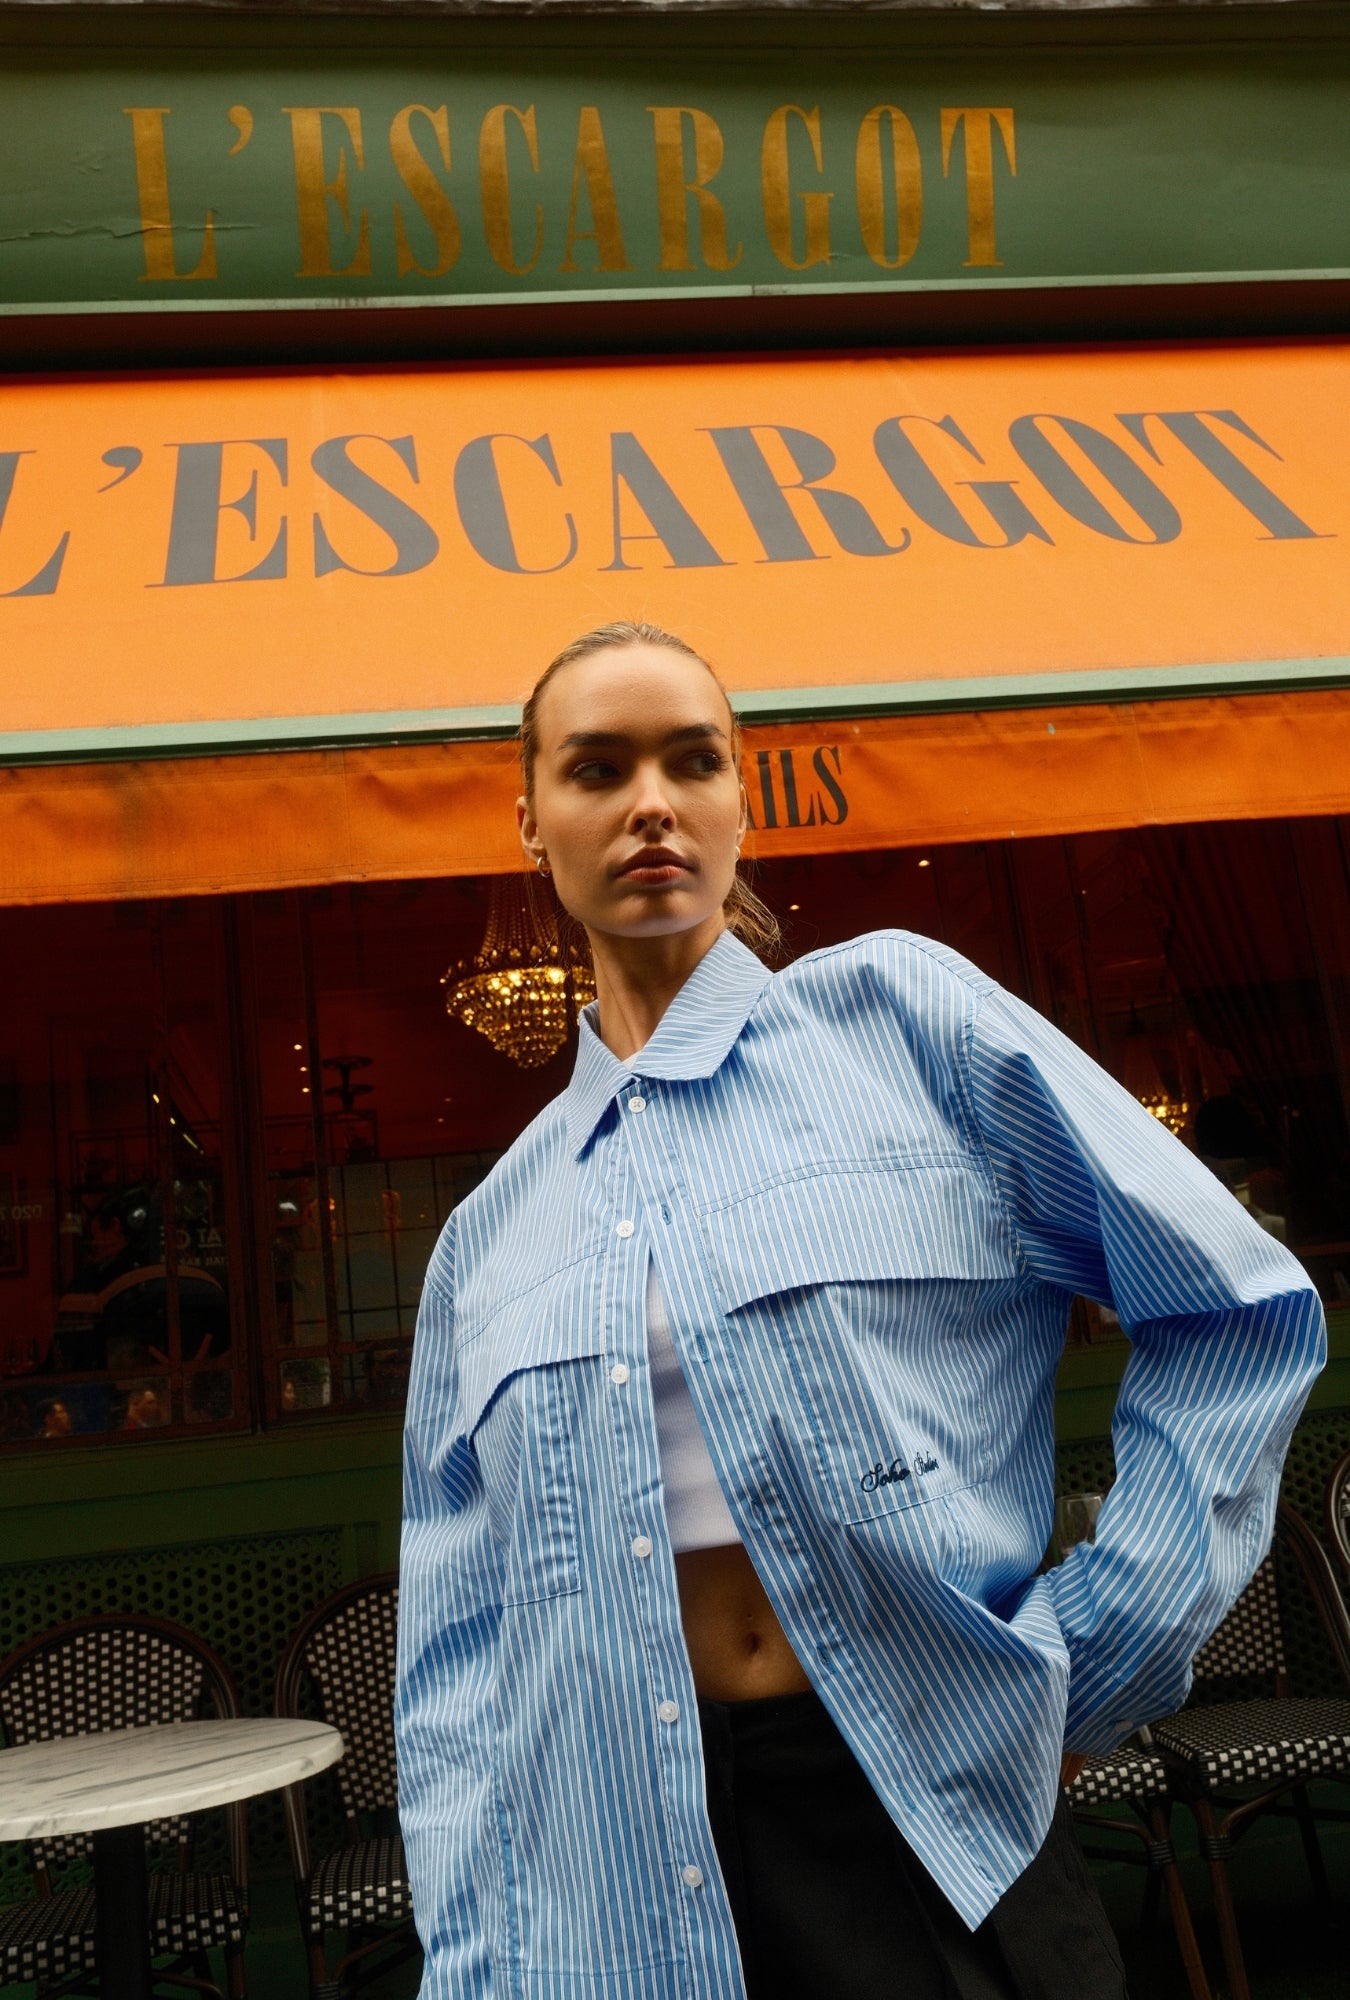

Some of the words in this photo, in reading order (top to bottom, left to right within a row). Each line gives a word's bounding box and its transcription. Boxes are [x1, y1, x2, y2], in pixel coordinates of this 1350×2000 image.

[121, 103, 1017, 282] L'ESCARGOT
[746, 745, 849, 830] ILS
[861, 1458, 911, 1493] Soho
